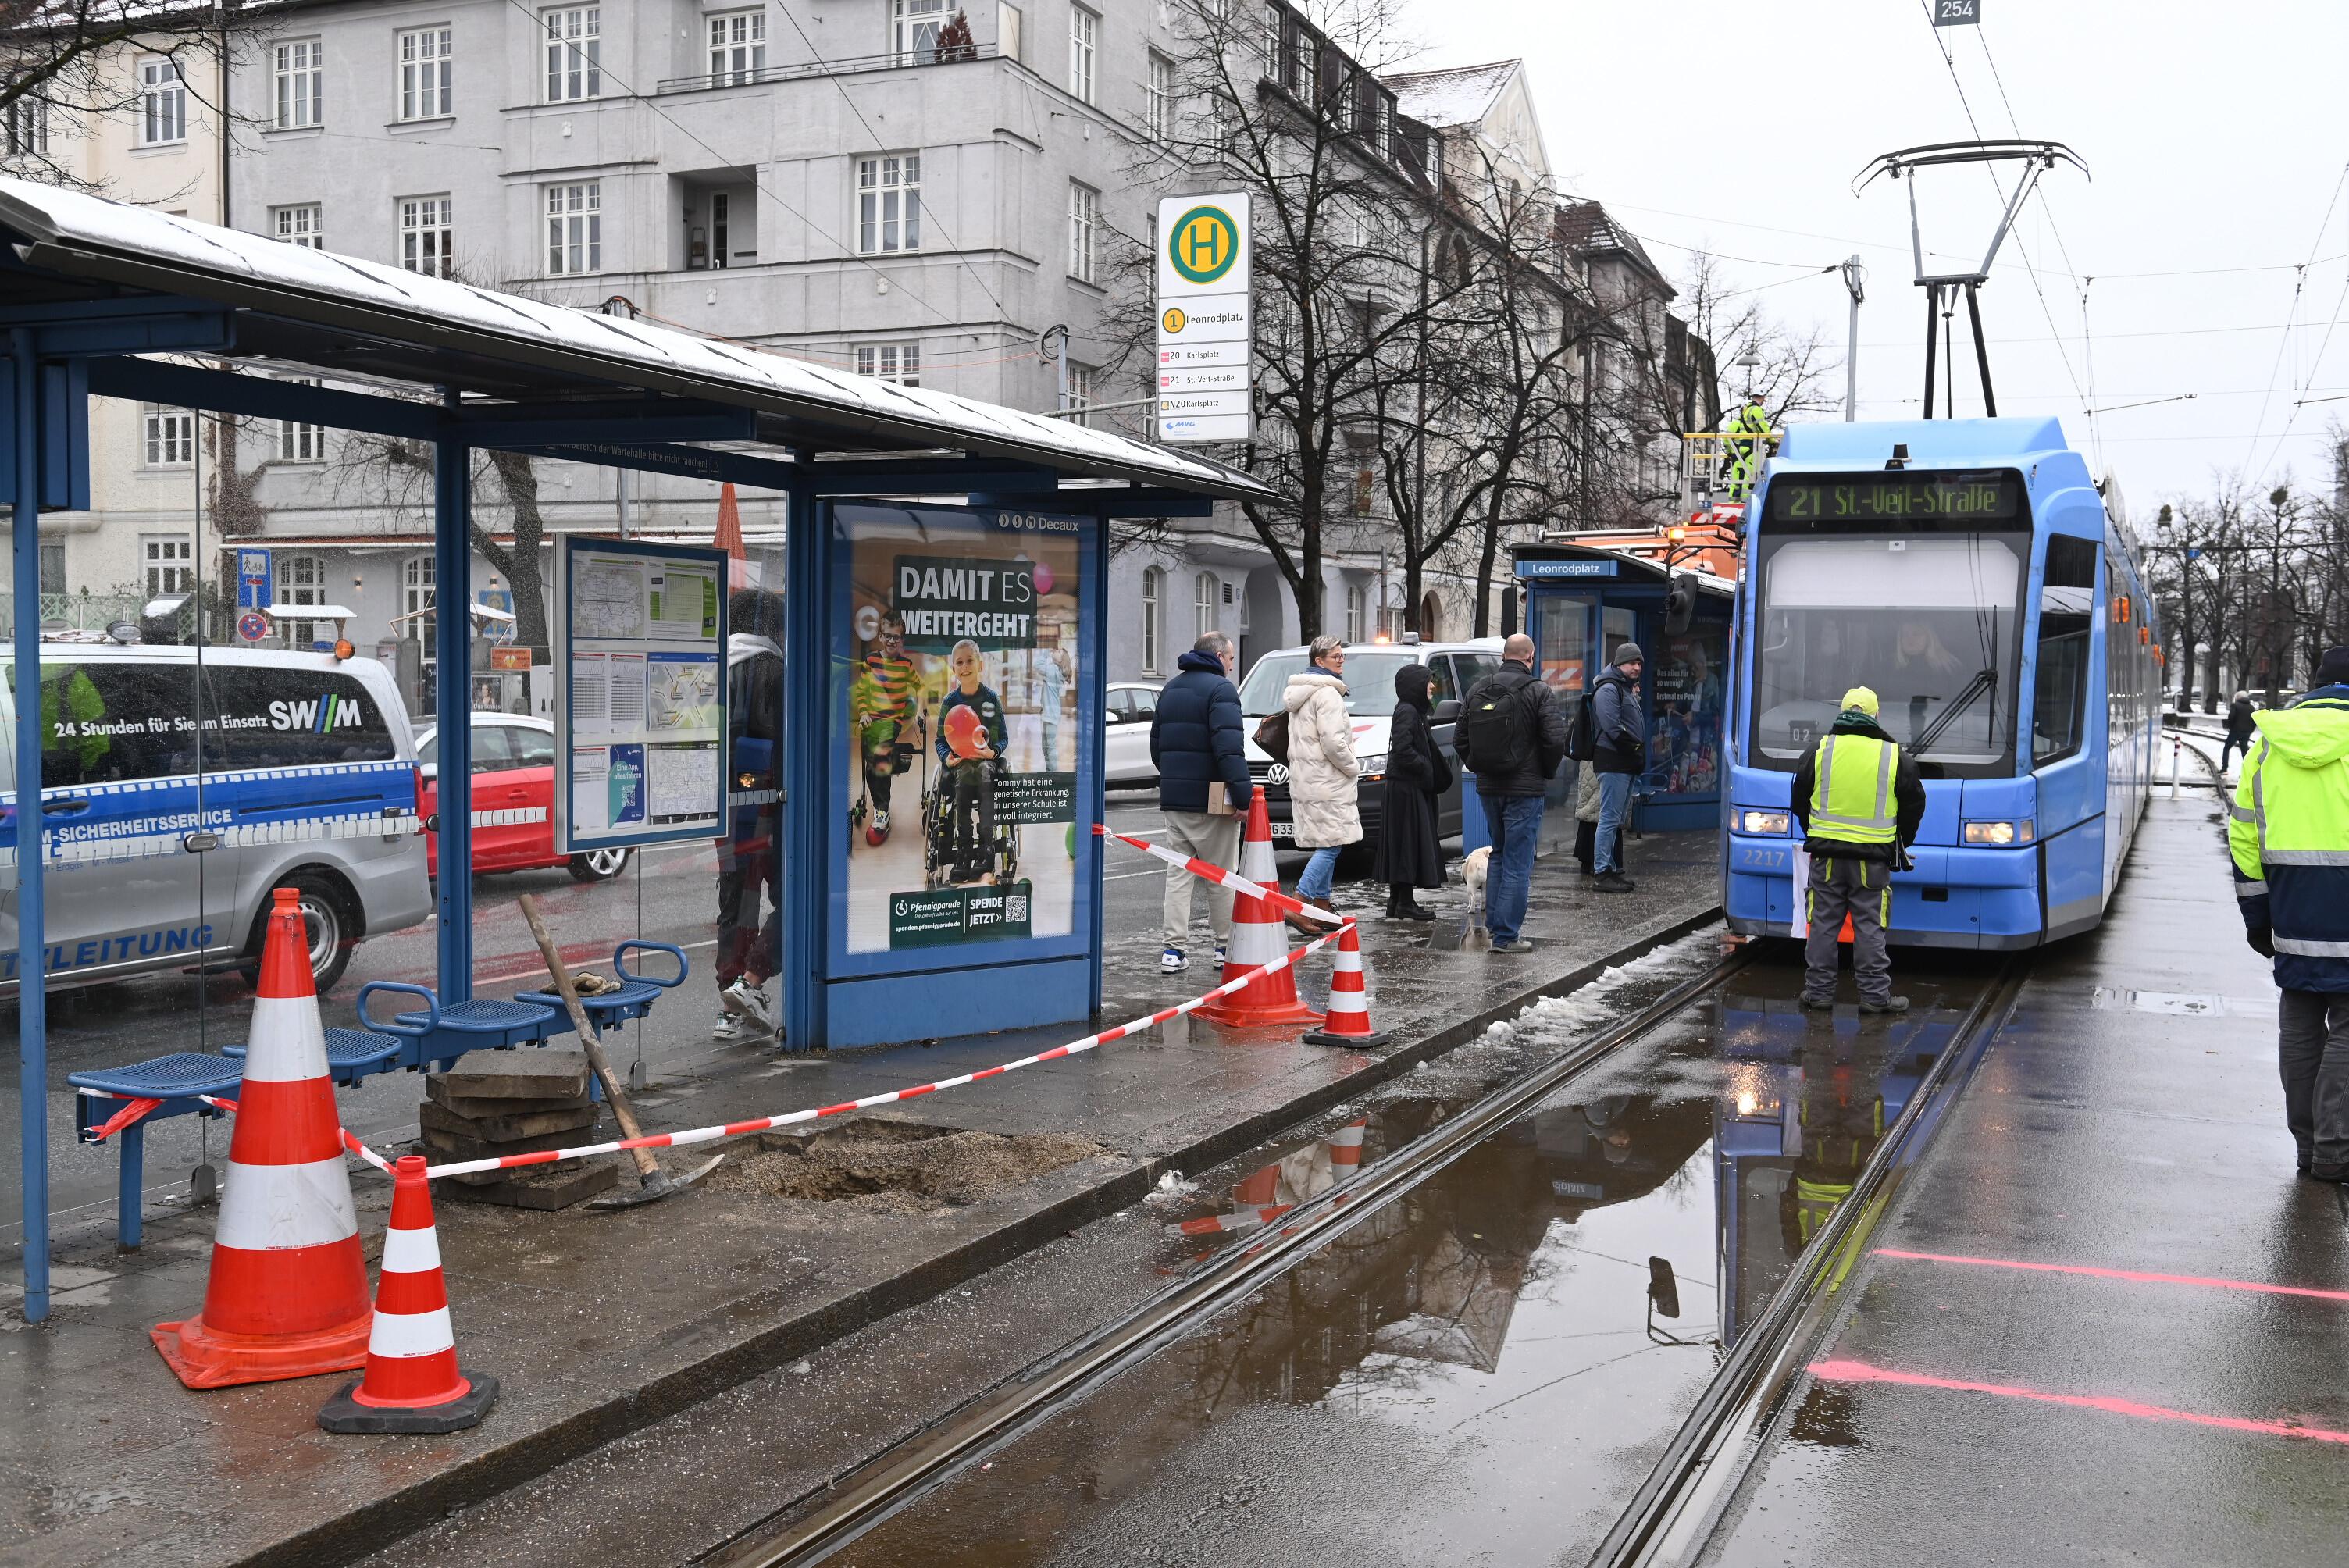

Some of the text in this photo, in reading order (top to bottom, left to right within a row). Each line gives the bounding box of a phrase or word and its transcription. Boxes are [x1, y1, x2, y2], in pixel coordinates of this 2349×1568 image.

[1941, 1, 1973, 17] 254
[1190, 223, 1217, 266] H
[1170, 313, 1244, 328] 1 Leonrodplatz
[1171, 351, 1180, 360] 20
[1187, 351, 1219, 360] Karlsplatz
[1171, 376, 1180, 384] 21
[1187, 374, 1235, 384] St.-Veit-Straße
[1171, 399, 1219, 408] N20 Karlsplatz
[599, 445, 609, 454] der
[611, 447, 647, 460] Wartehalle
[648, 449, 663, 462] bitte
[665, 452, 681, 465] nicht
[682, 455, 708, 469] rauchen!
[1791, 483, 1996, 516] 21 St.-Veit-Straße
[1039, 517, 1079, 532] Decaux
[1532, 564, 1600, 576] Leonrodplatz
[900, 566, 1031, 603] DAMIT ES
[901, 610, 1030, 638] WEITERGEHT
[1663, 679, 1684, 688] wenig?
[54, 722, 77, 738] 24
[80, 718, 144, 736] Stunden
[148, 716, 169, 732] für
[174, 716, 197, 732] Sie
[220, 714, 268, 730] Einsatz
[994, 779, 1021, 789] Tommy
[1023, 778, 1035, 786] hat
[993, 788, 1070, 800] genetische Erkrankung.
[993, 801, 1000, 810] In
[1032, 799, 1057, 808] Schule
[1058, 798, 1068, 807] ist
[1003, 811, 1016, 820] voll
[1018, 810, 1054, 821] integriert.
[1743, 849, 1785, 868] 2217
[56, 861, 84, 871] Erdgas
[911, 900, 961, 914] Pfennigparade
[970, 897, 1003, 910] SPENDE
[895, 921, 961, 933] spenden.pfennigparade.de
